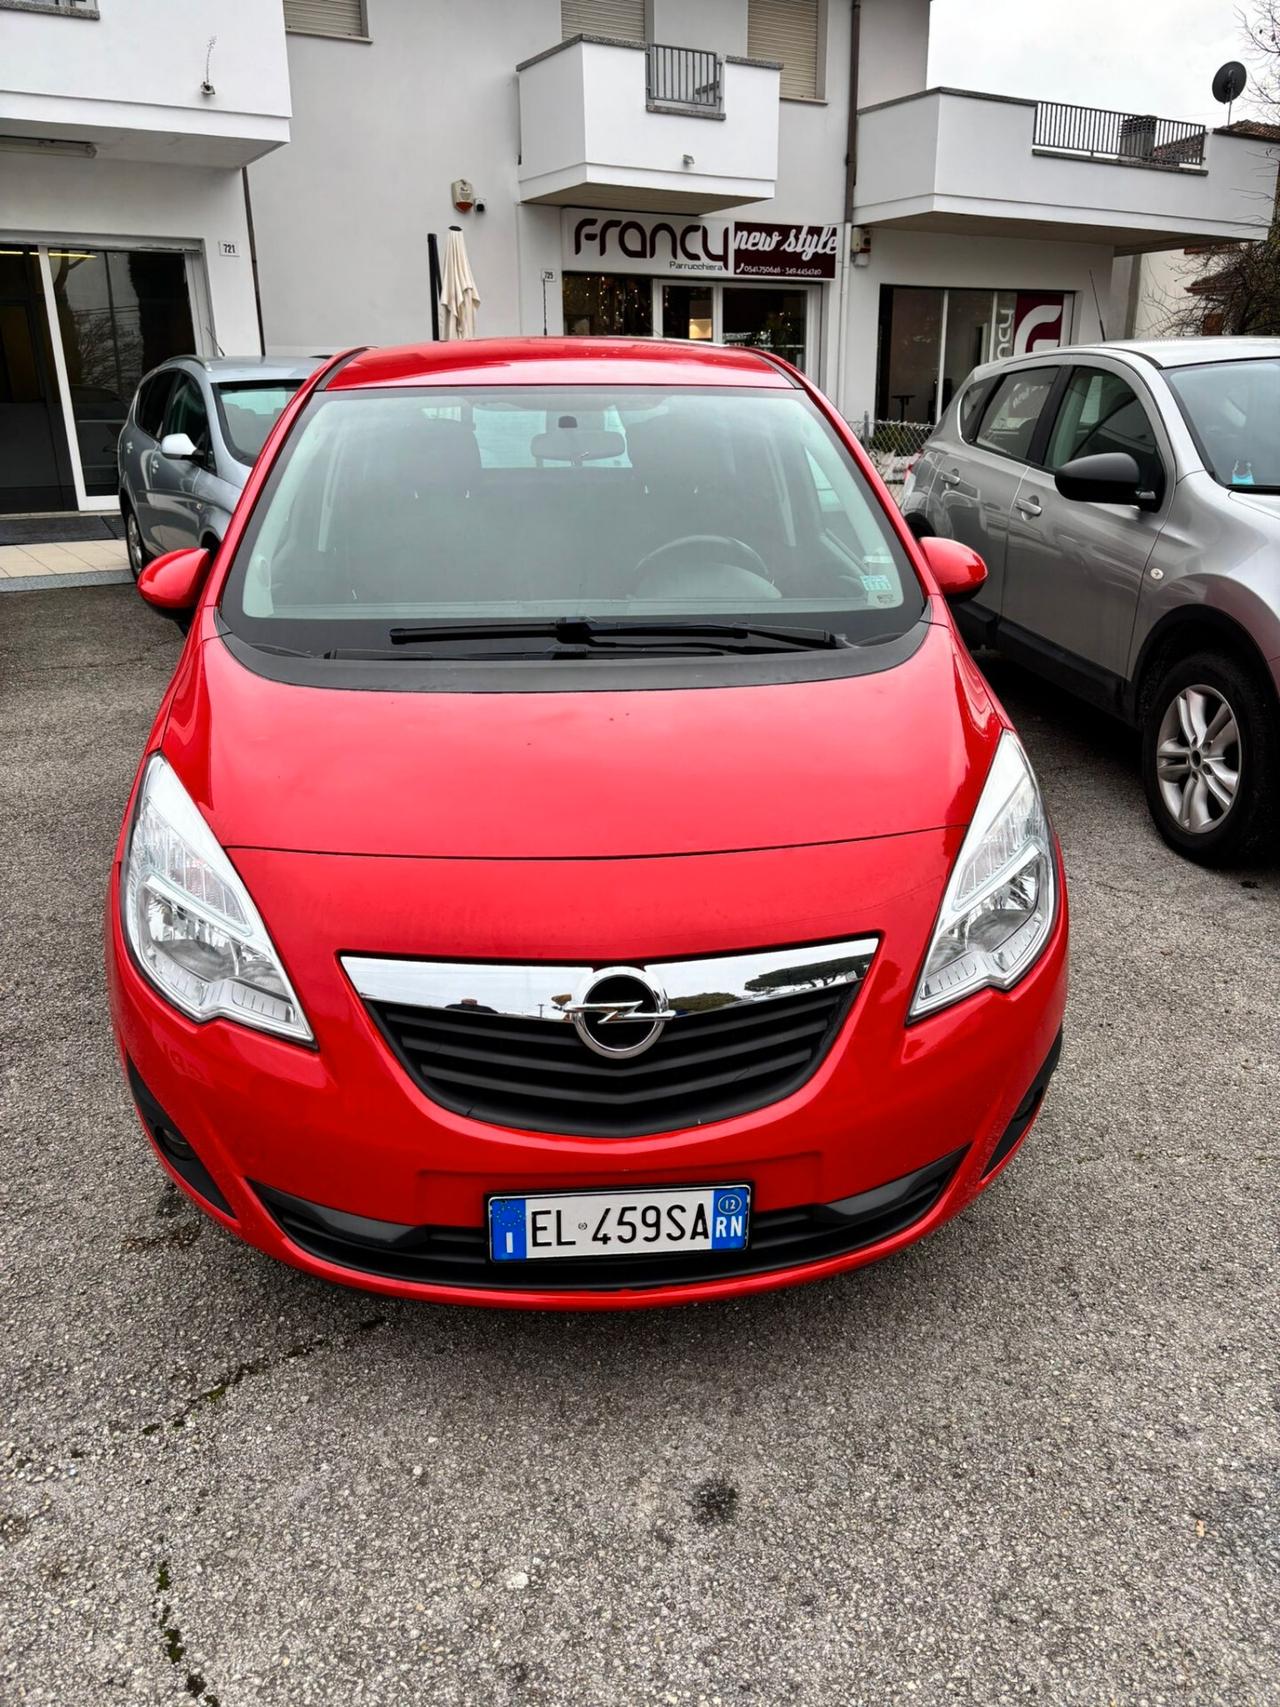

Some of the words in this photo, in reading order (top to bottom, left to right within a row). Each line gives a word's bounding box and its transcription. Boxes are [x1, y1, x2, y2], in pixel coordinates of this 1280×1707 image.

[223, 243, 236, 254] 721
[734, 230, 782, 251] new
[780, 224, 837, 261] style
[669, 261, 723, 272] Parrucchiera
[725, 1200, 736, 1210] 12
[531, 1209, 576, 1247] EL
[591, 1202, 710, 1245] 459SA
[715, 1215, 742, 1238] RN
